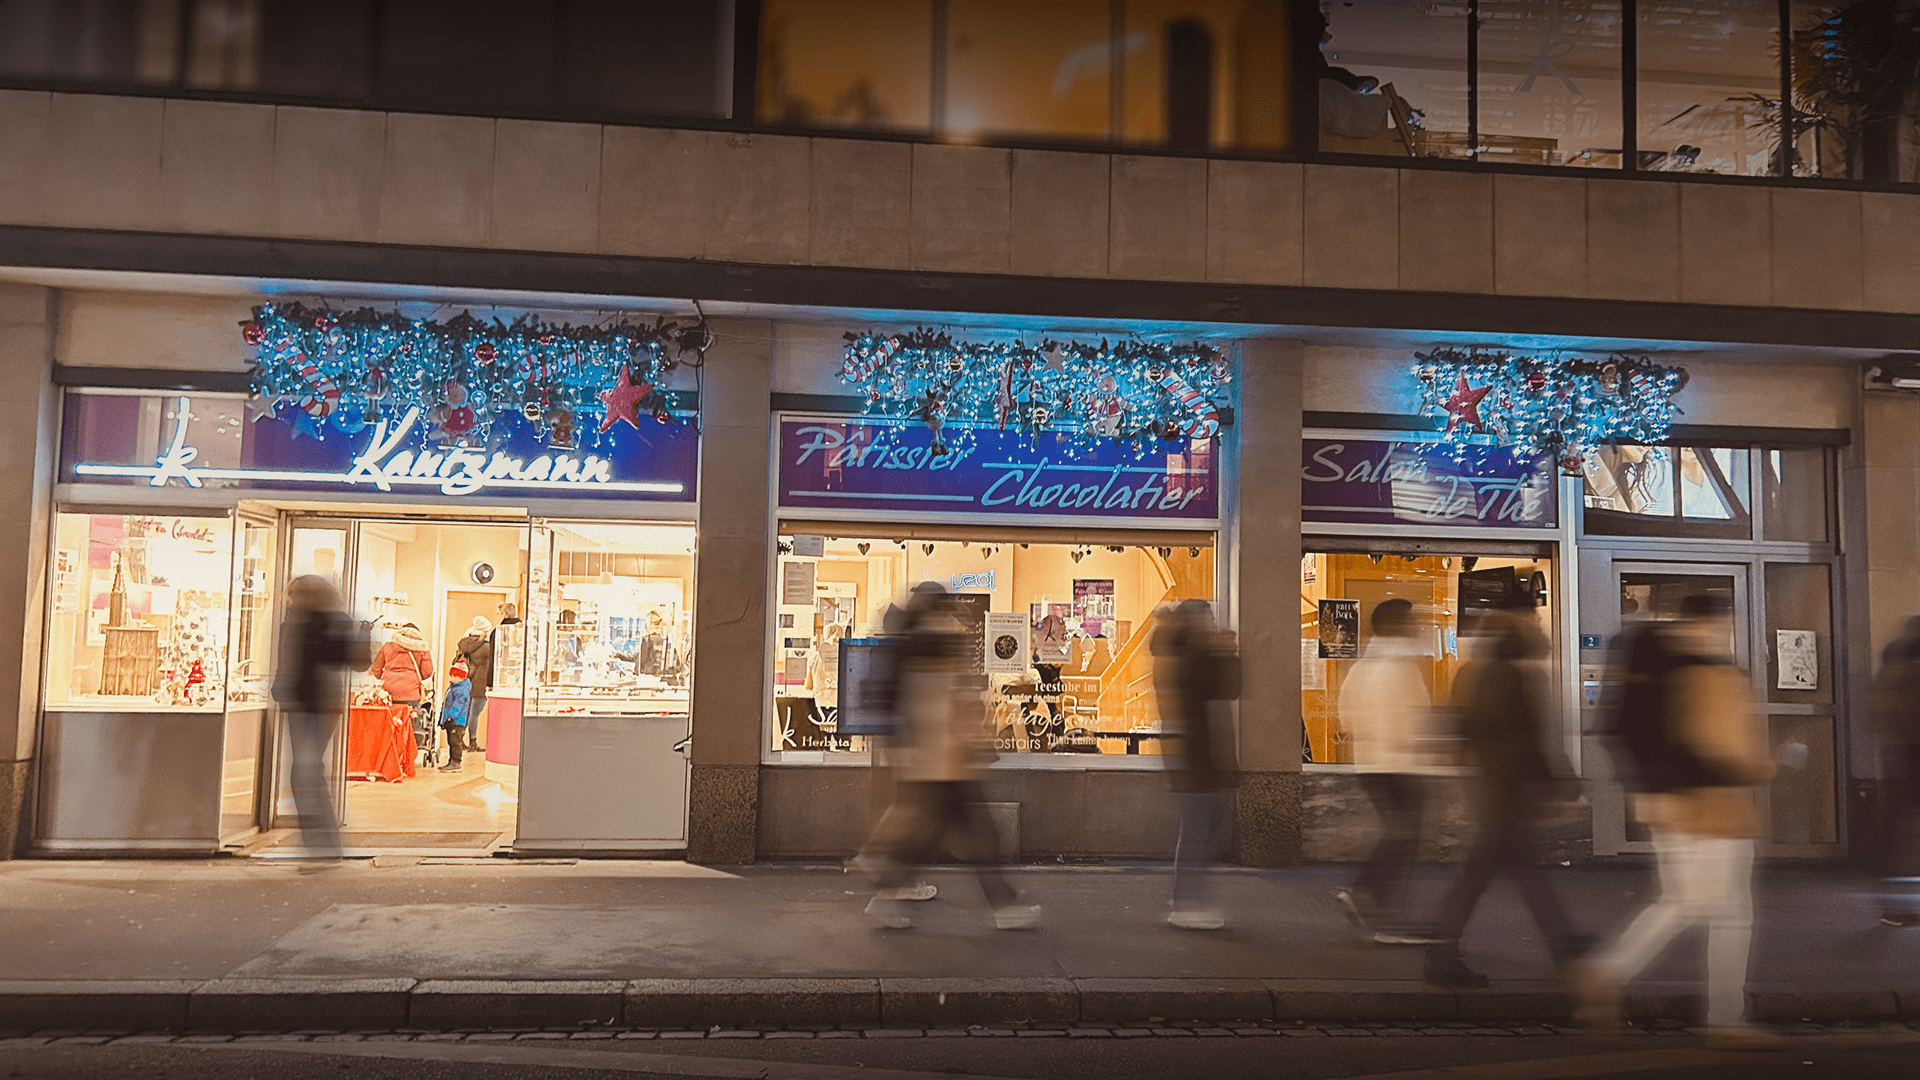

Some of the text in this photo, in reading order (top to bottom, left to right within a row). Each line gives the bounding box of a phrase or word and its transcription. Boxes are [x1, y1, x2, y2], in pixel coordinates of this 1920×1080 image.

[149, 395, 203, 488] k
[348, 406, 611, 496] Kautzmann
[795, 426, 976, 471] Pâtissier
[1302, 442, 1431, 484] Salon
[980, 456, 1204, 511] Chocolatier
[1425, 472, 1549, 522] de Thé
[1588, 636, 1595, 647] 2
[780, 705, 798, 748] k
